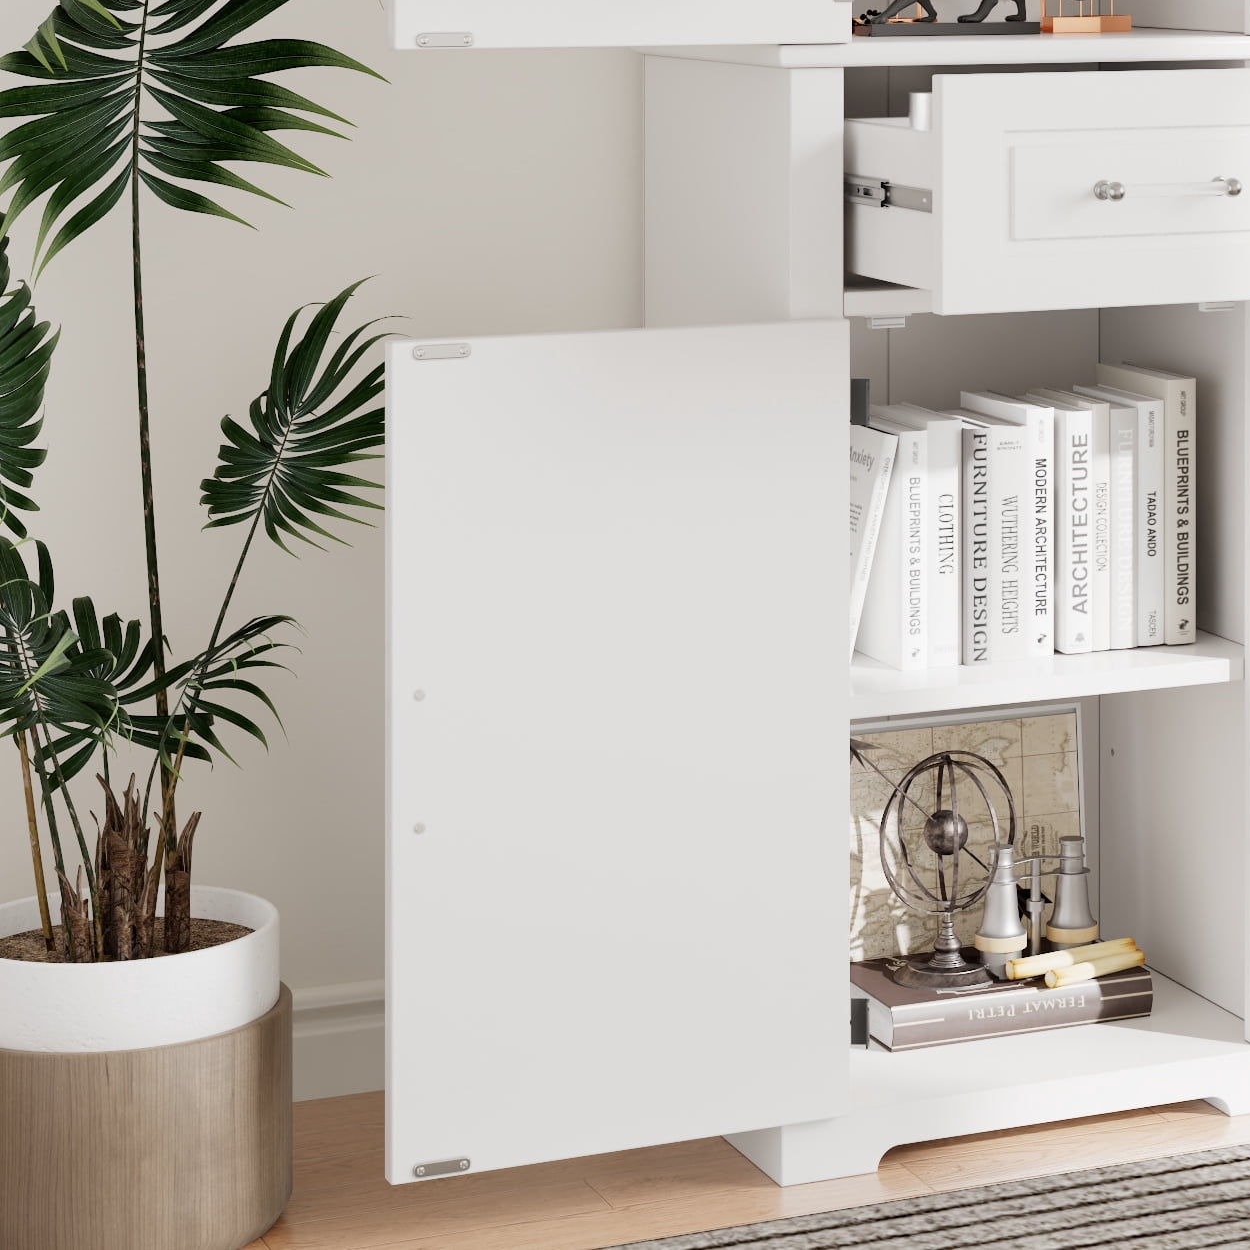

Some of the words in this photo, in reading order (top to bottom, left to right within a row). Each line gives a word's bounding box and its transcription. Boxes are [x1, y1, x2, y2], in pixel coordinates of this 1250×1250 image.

[973, 433, 988, 569] FURNITURE
[1035, 458, 1047, 513] MODERN
[1096, 482, 1108, 515] DESIGN
[1176, 429, 1190, 515] BLUEPRINTS
[909, 477, 921, 553] BLUEPRINTS
[938, 494, 954, 575] CLOTHING
[1001, 495, 1018, 573] WUTHERING
[1071, 433, 1089, 615] ARCHITECTURE
[1146, 491, 1158, 526] TADAO
[1176, 518, 1190, 529] &
[909, 556, 921, 566] &
[1035, 516, 1047, 615] ARCHITECTURE
[1096, 517, 1108, 572] COLLECTION
[1146, 528, 1158, 557] ANDO
[1176, 532, 1190, 605] BUILDINGS
[909, 569, 921, 636] BUILDINGS
[973, 576, 988, 662] DESIGN
[1001, 579, 1019, 634] HEIGHTS
[968, 1005, 1016, 1021] PETRI
[1022, 995, 1086, 1014] FERMAT
